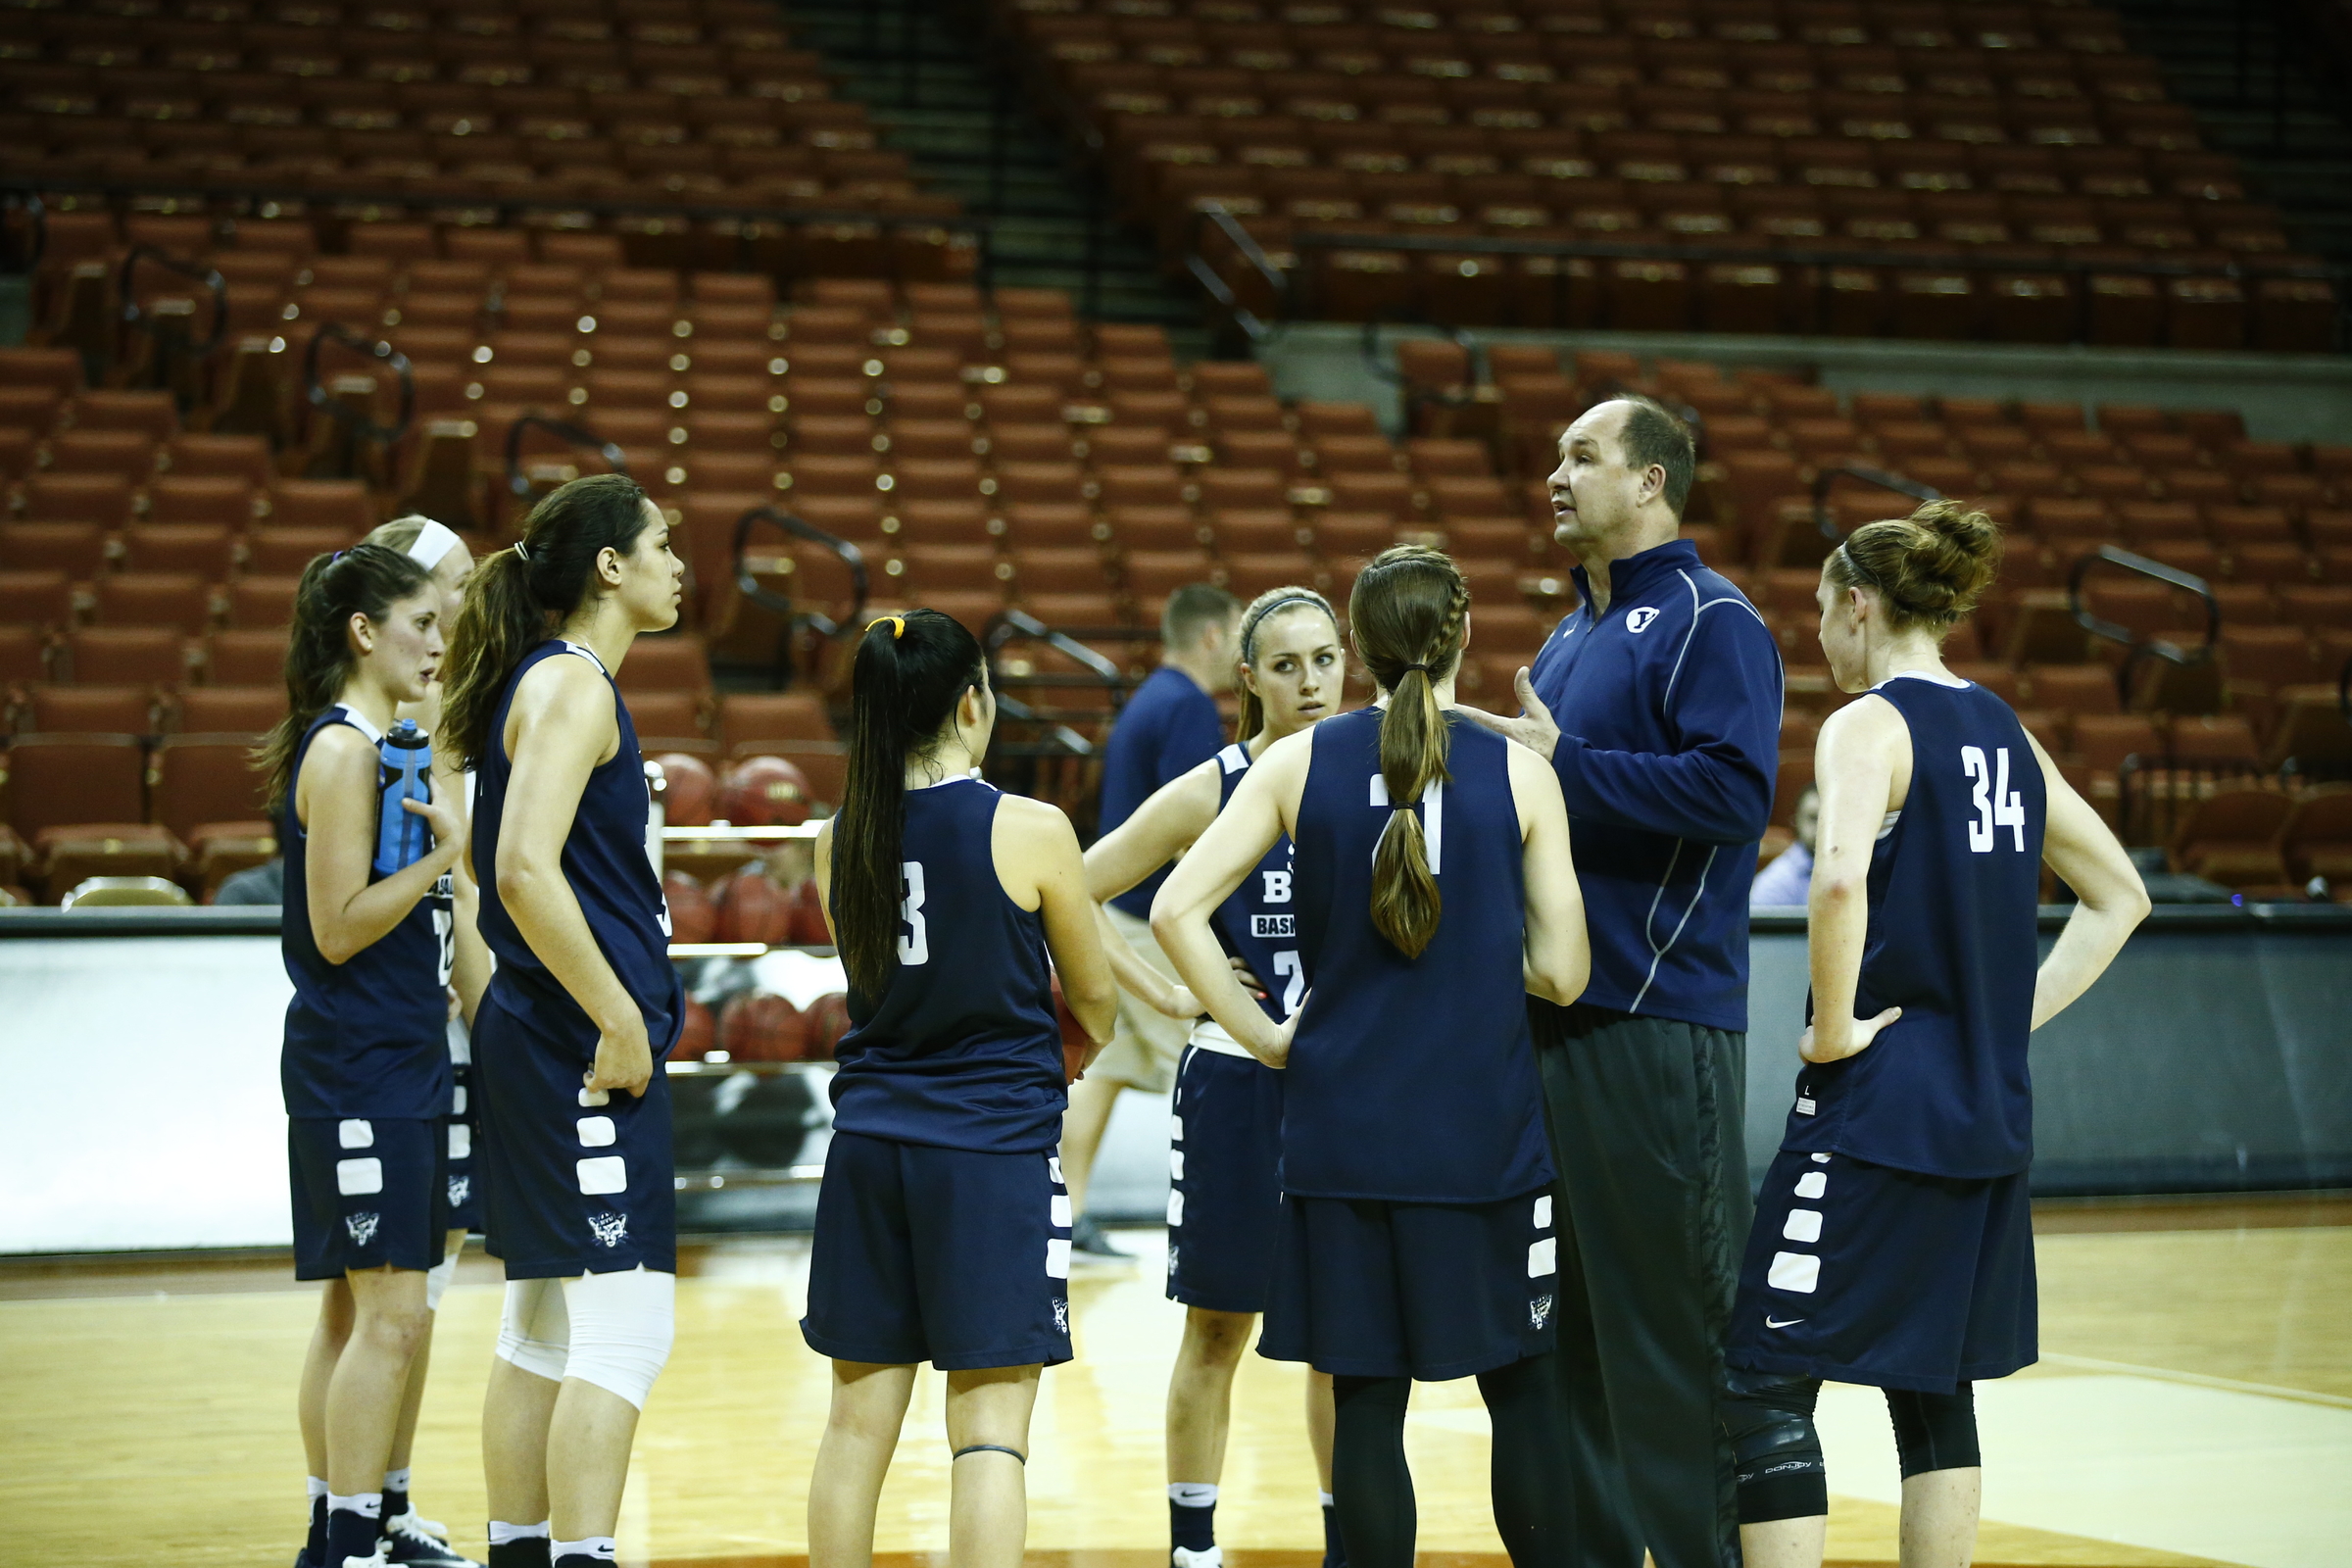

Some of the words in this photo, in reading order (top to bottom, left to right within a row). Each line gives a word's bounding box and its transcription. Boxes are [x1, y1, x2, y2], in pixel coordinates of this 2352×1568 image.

[1961, 745, 2026, 853] 34
[1262, 870, 1293, 904] B
[1764, 1461, 1812, 1474] DONJOY
